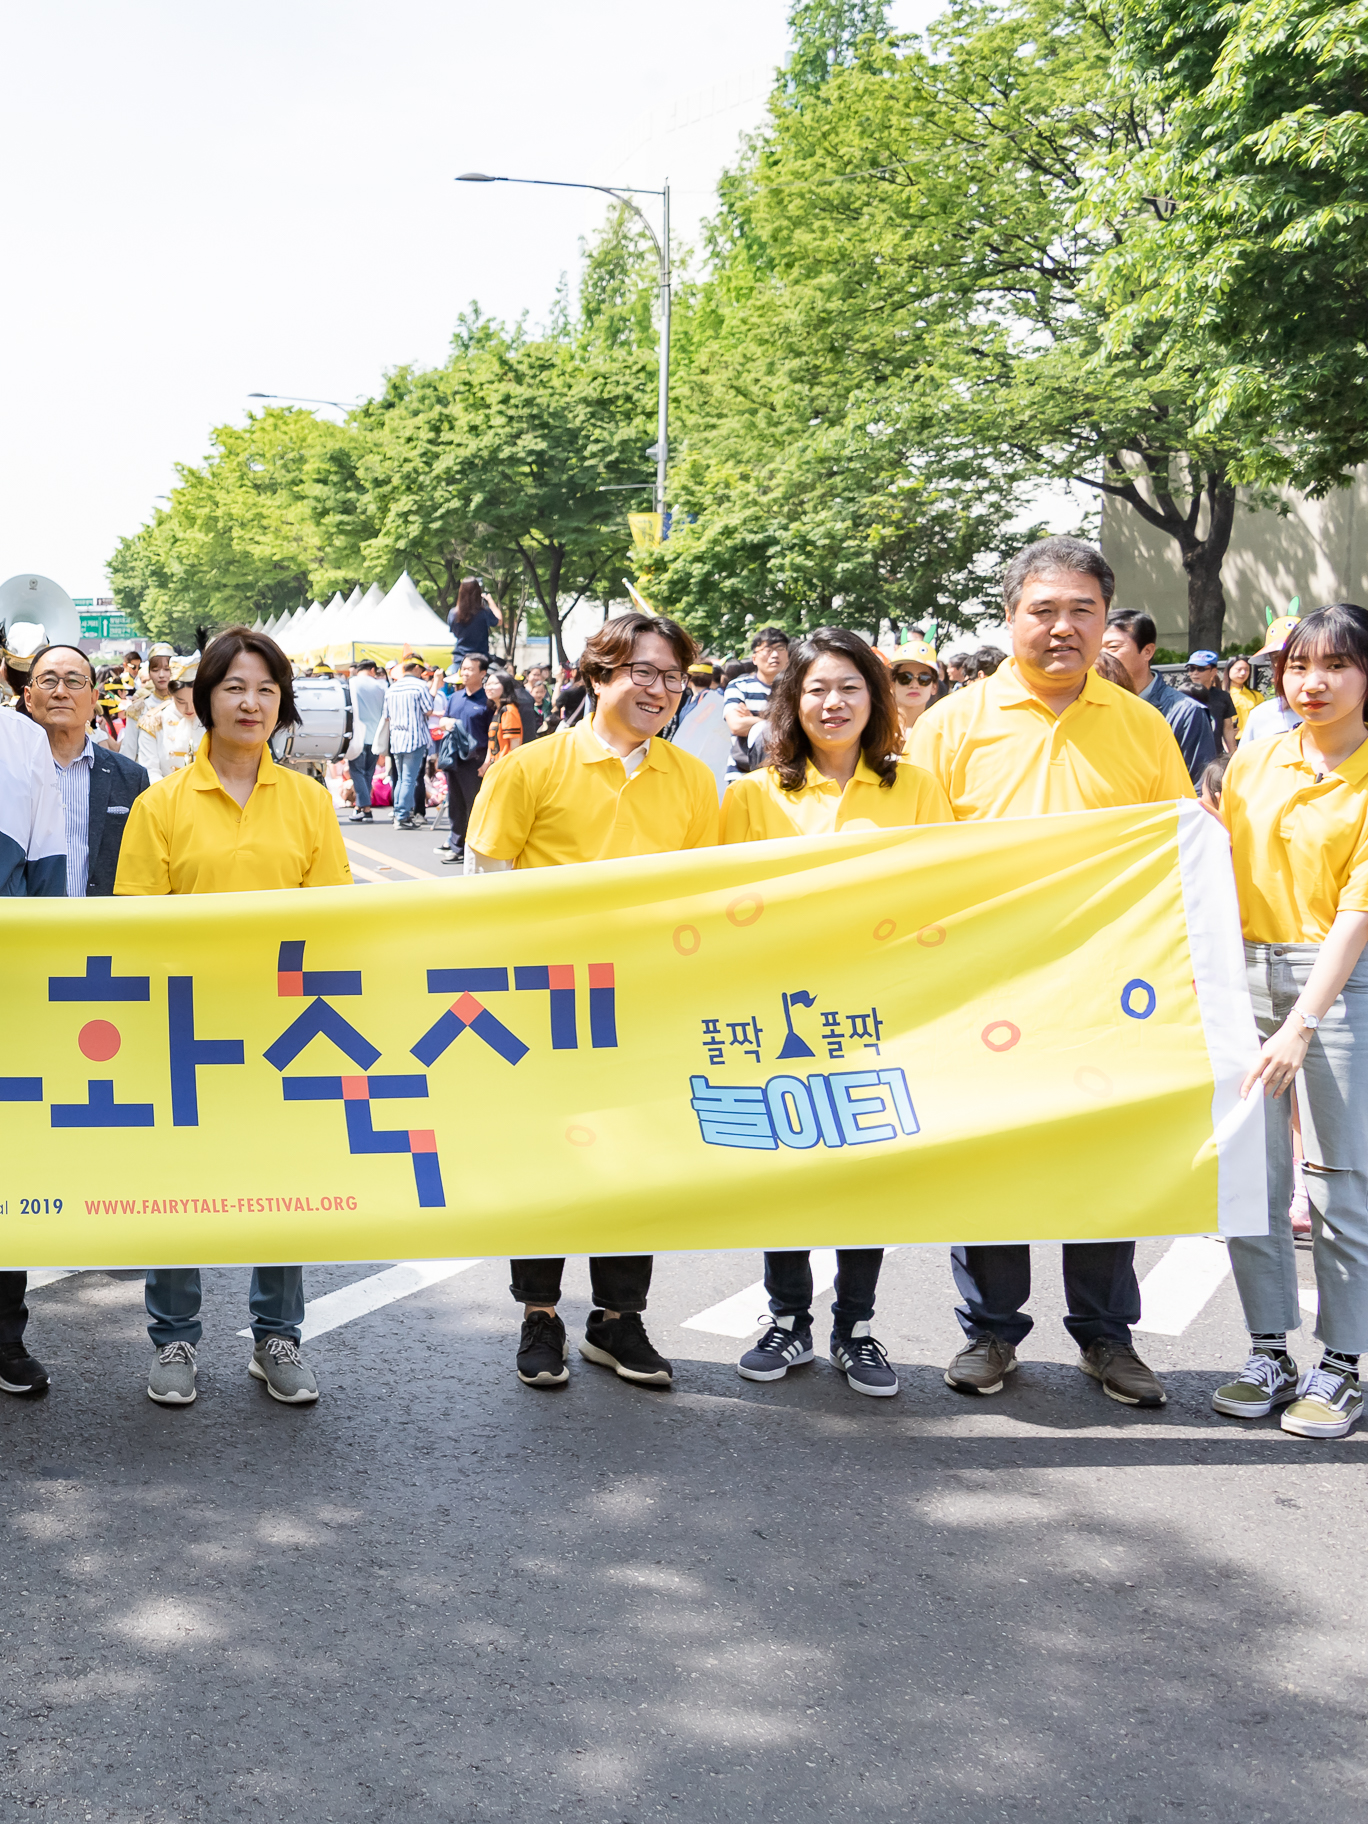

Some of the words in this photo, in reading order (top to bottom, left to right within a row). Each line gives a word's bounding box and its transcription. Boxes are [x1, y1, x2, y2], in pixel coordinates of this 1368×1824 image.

[700, 1015, 764, 1066] 폴짝
[819, 1006, 884, 1059] 폴짝
[689, 1067, 921, 1151] 놀이터
[19, 1198, 63, 1215] 2019
[84, 1195, 358, 1215] WWW.FAIRYTALE-FESTIVAL.ORG
